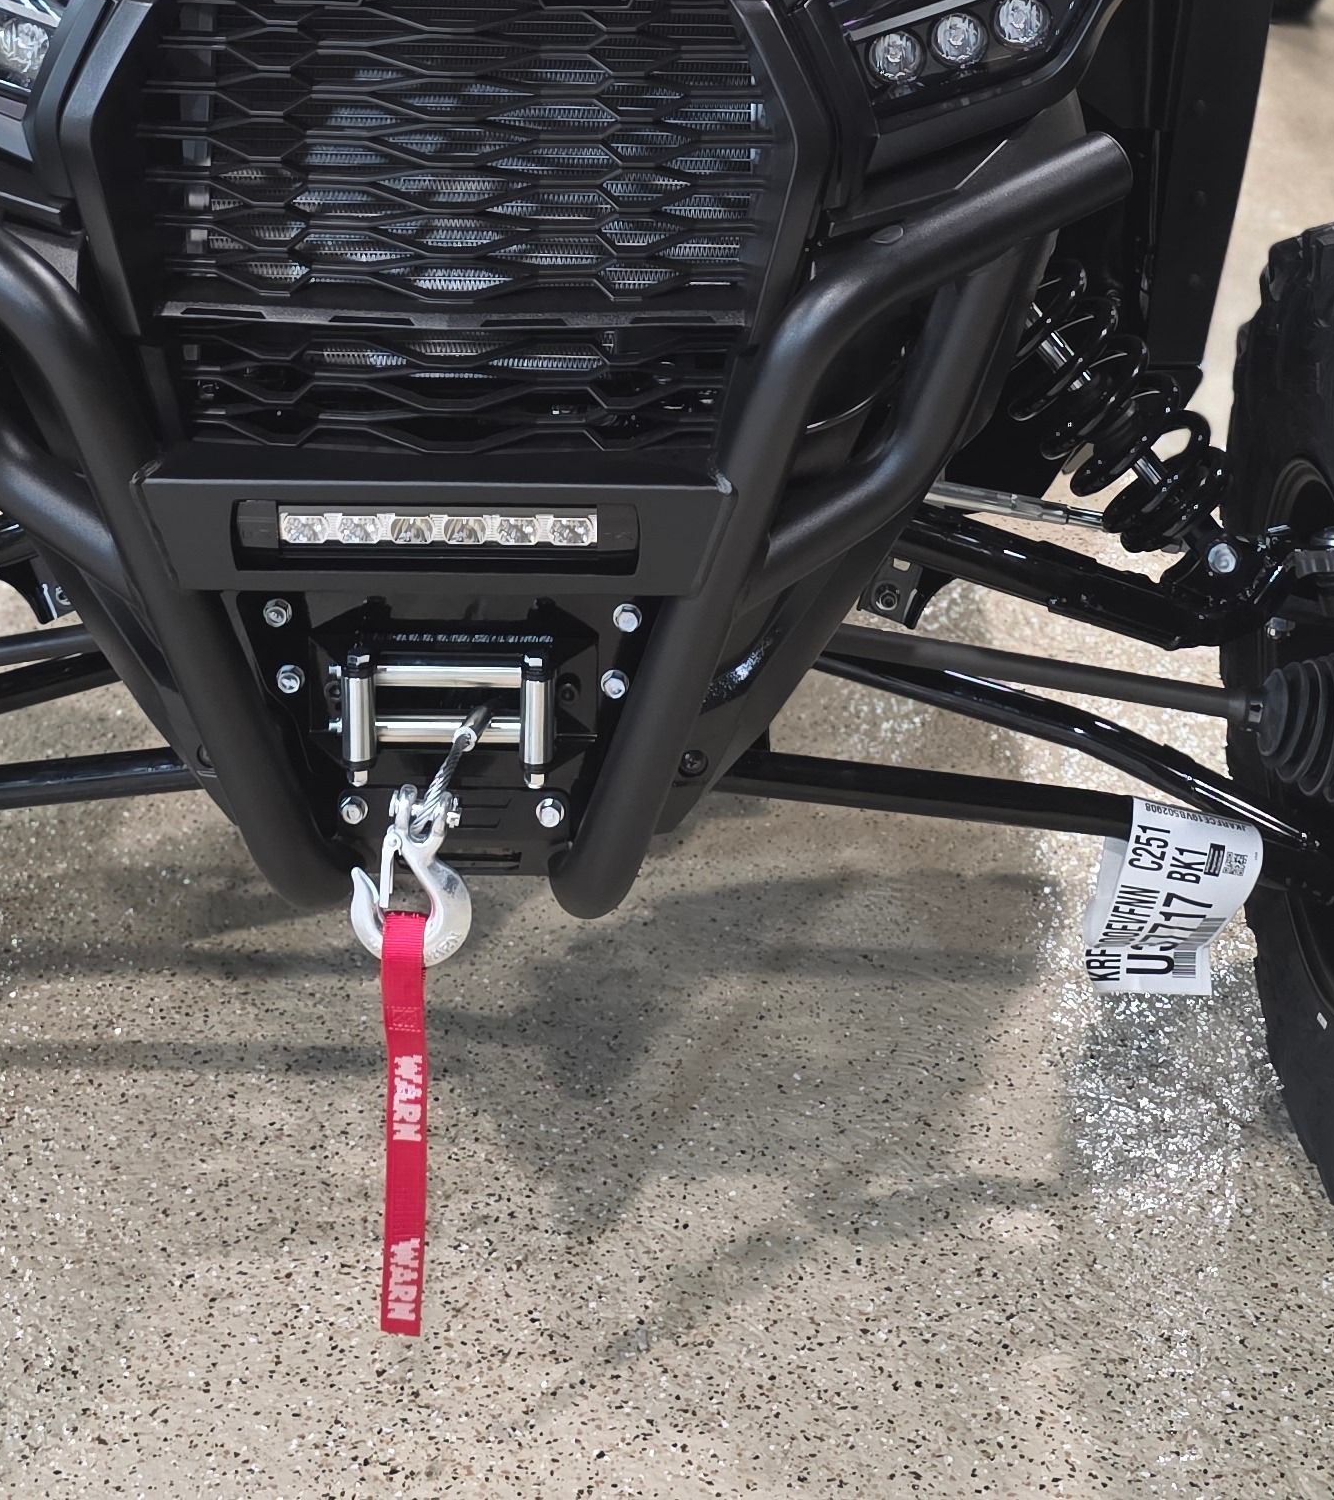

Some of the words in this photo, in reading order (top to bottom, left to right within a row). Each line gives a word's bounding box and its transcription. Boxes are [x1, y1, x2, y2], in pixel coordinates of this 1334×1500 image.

[1085, 884, 1160, 982] KRF100EVFNN
[1128, 824, 1171, 872] C251
[1166, 847, 1208, 885] BK1
[1125, 892, 1213, 975] U37717
[392, 1054, 423, 1142] WARN
[387, 1238, 421, 1321] WARN
